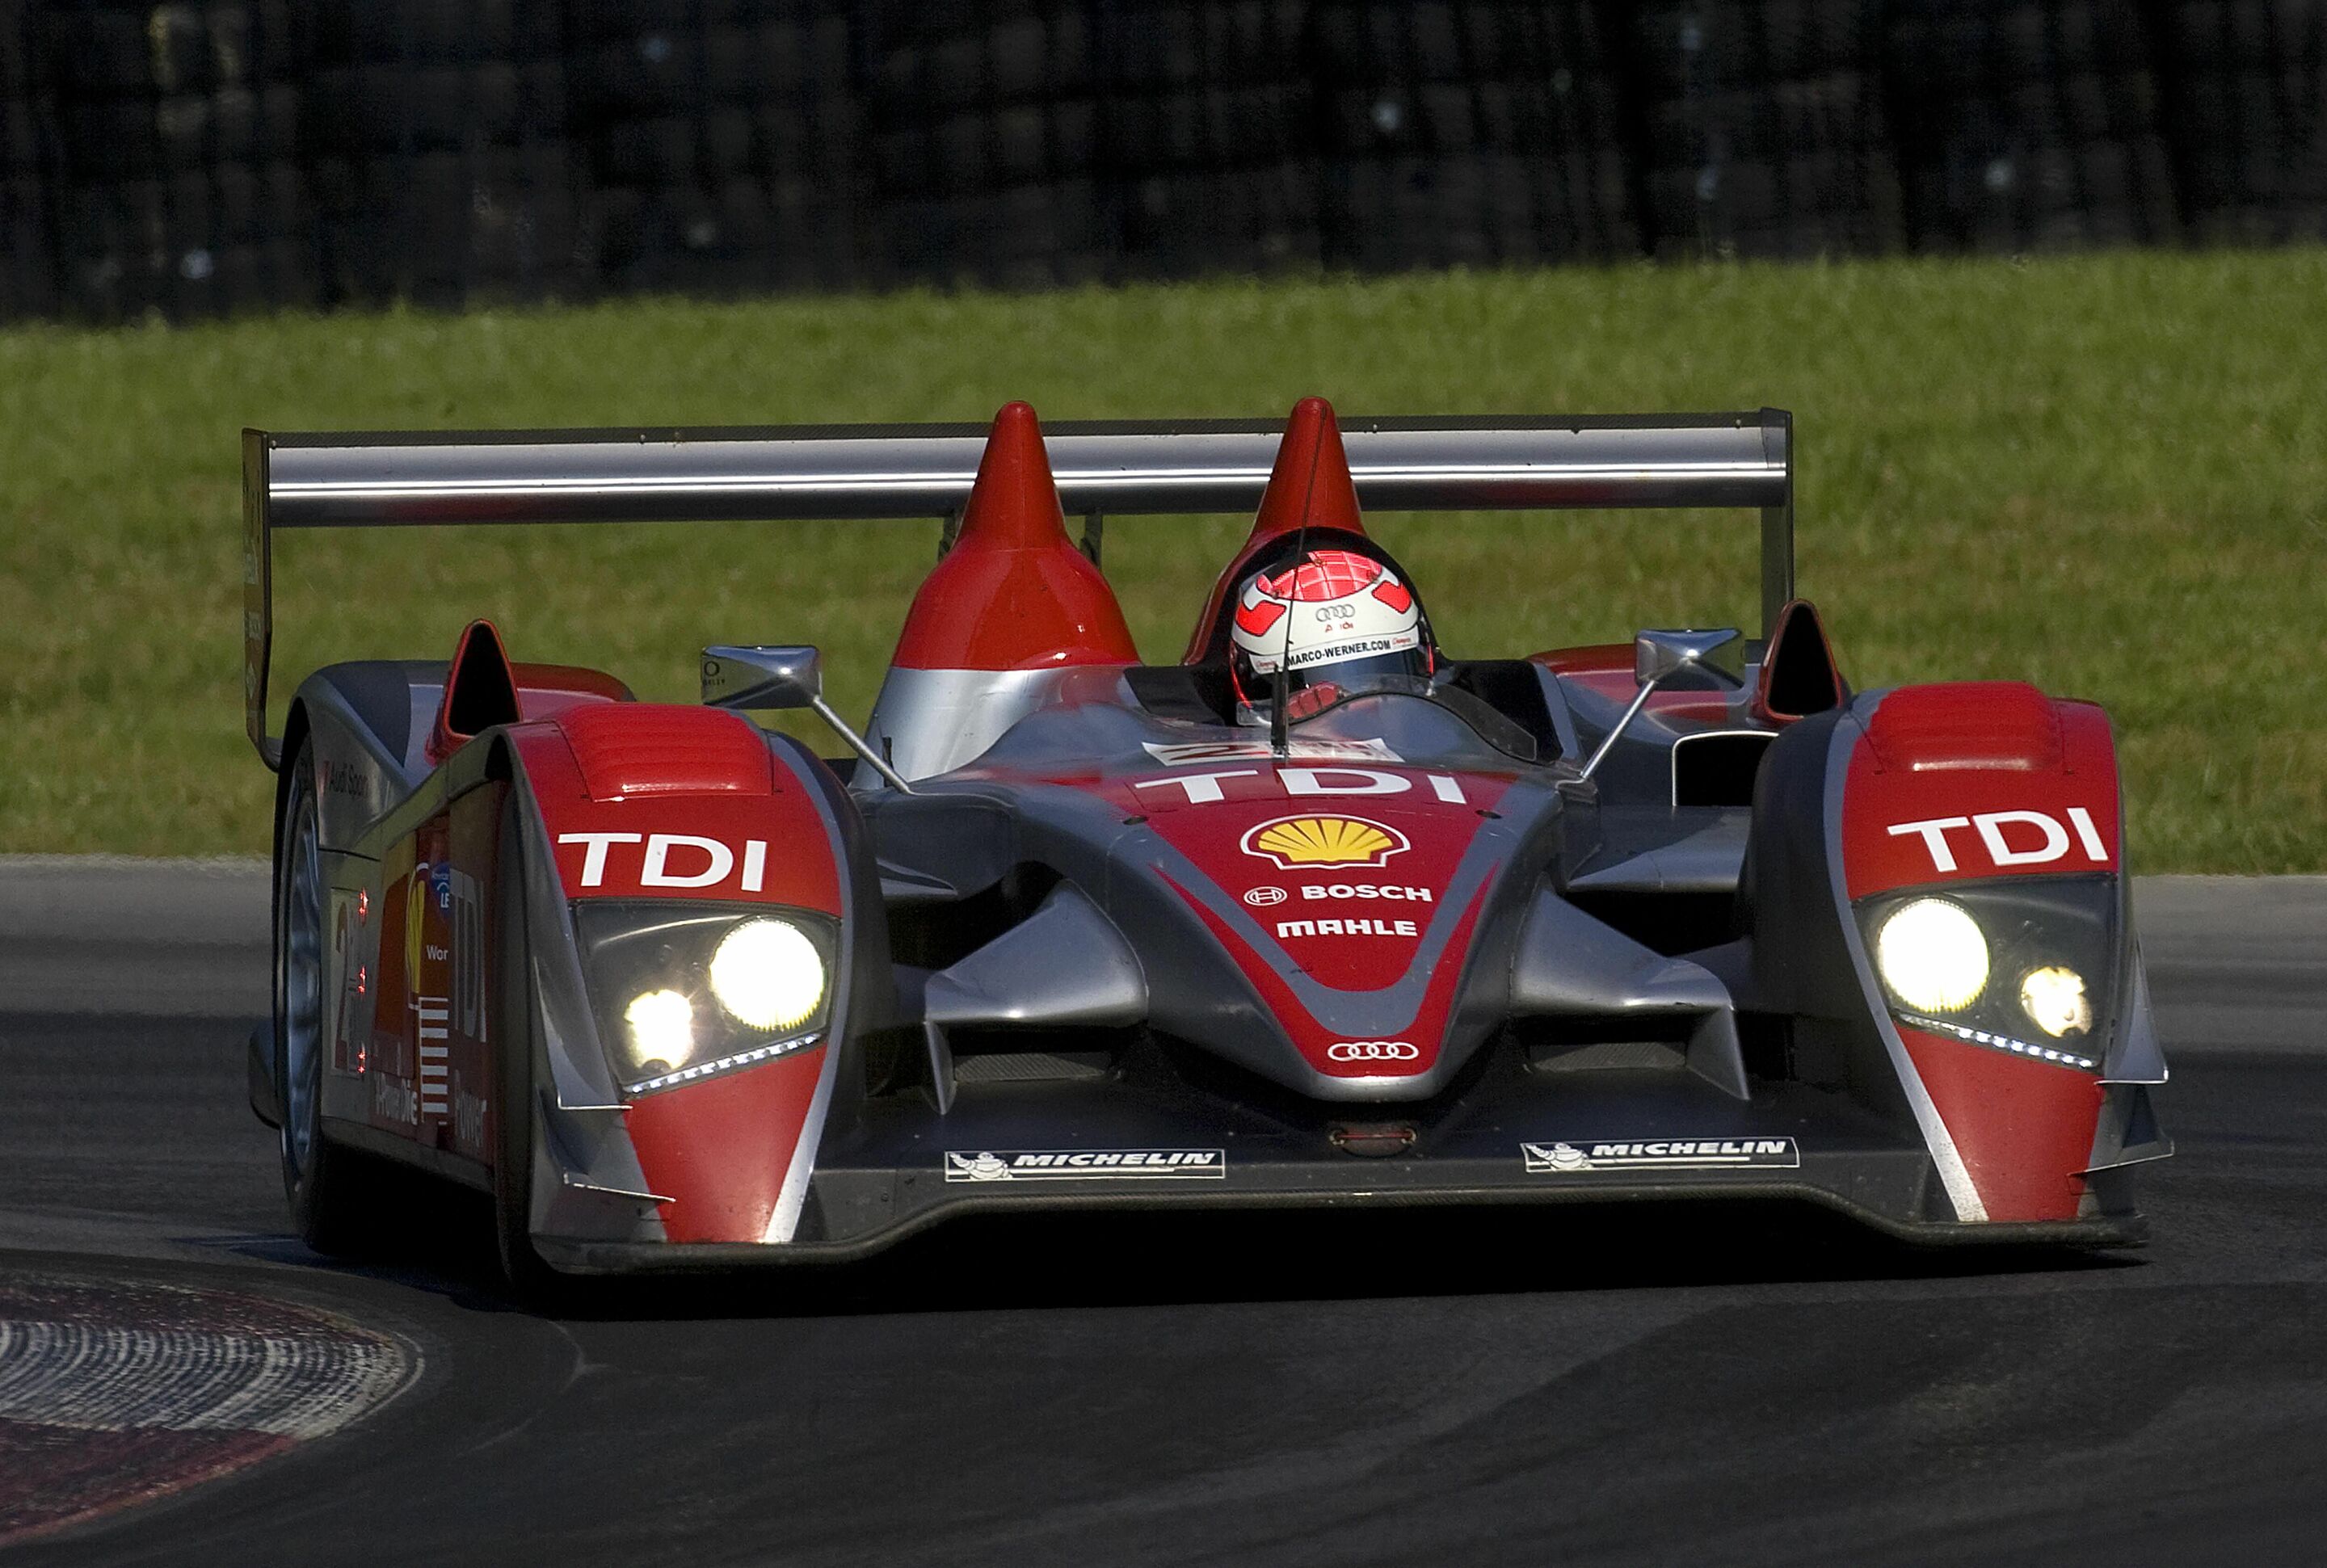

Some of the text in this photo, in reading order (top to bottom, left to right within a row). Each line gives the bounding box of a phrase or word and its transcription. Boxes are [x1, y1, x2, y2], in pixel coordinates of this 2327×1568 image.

[1287, 640, 1391, 666] MARCO-WERNER.COM
[1135, 767, 1466, 804] TDI
[1887, 807, 2109, 873] TDI
[557, 832, 768, 893] TDI
[1301, 885, 1433, 902] BOSCH
[1277, 919, 1418, 938] MAHLE
[335, 902, 348, 1070] 2
[1013, 1153, 1215, 1167] MICHELIN
[1592, 1141, 1786, 1156] MICHELIN
